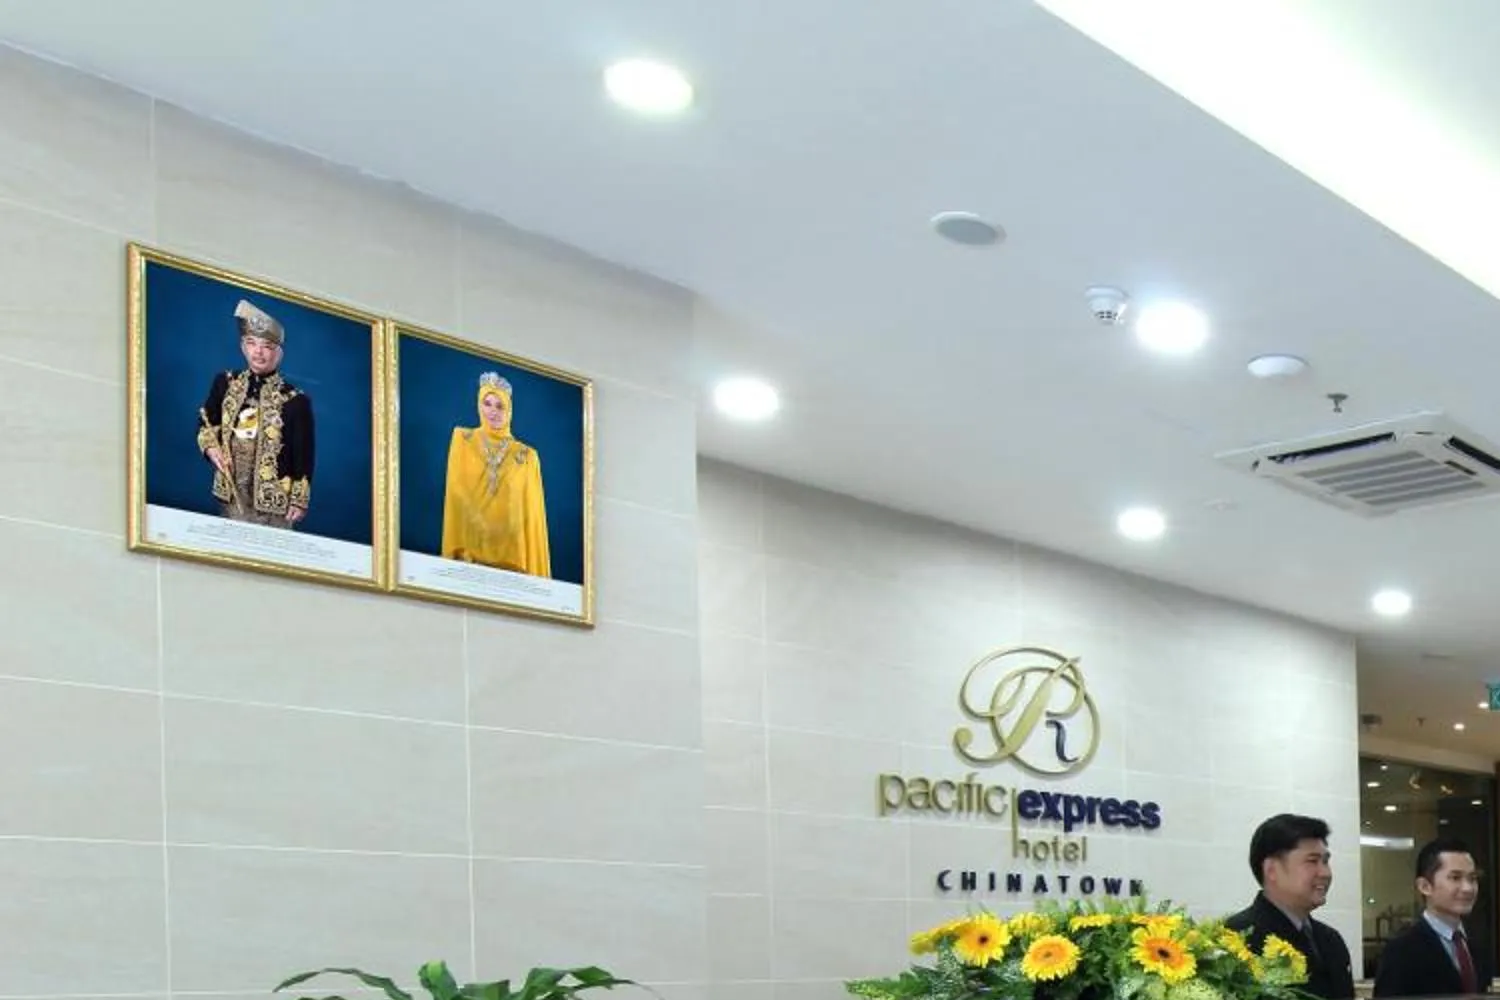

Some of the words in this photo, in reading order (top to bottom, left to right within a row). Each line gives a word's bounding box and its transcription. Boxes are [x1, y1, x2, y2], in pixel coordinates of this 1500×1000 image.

[878, 772, 1009, 817] pacific
[1017, 789, 1161, 833] express
[937, 869, 1144, 898] CHINATOWN
